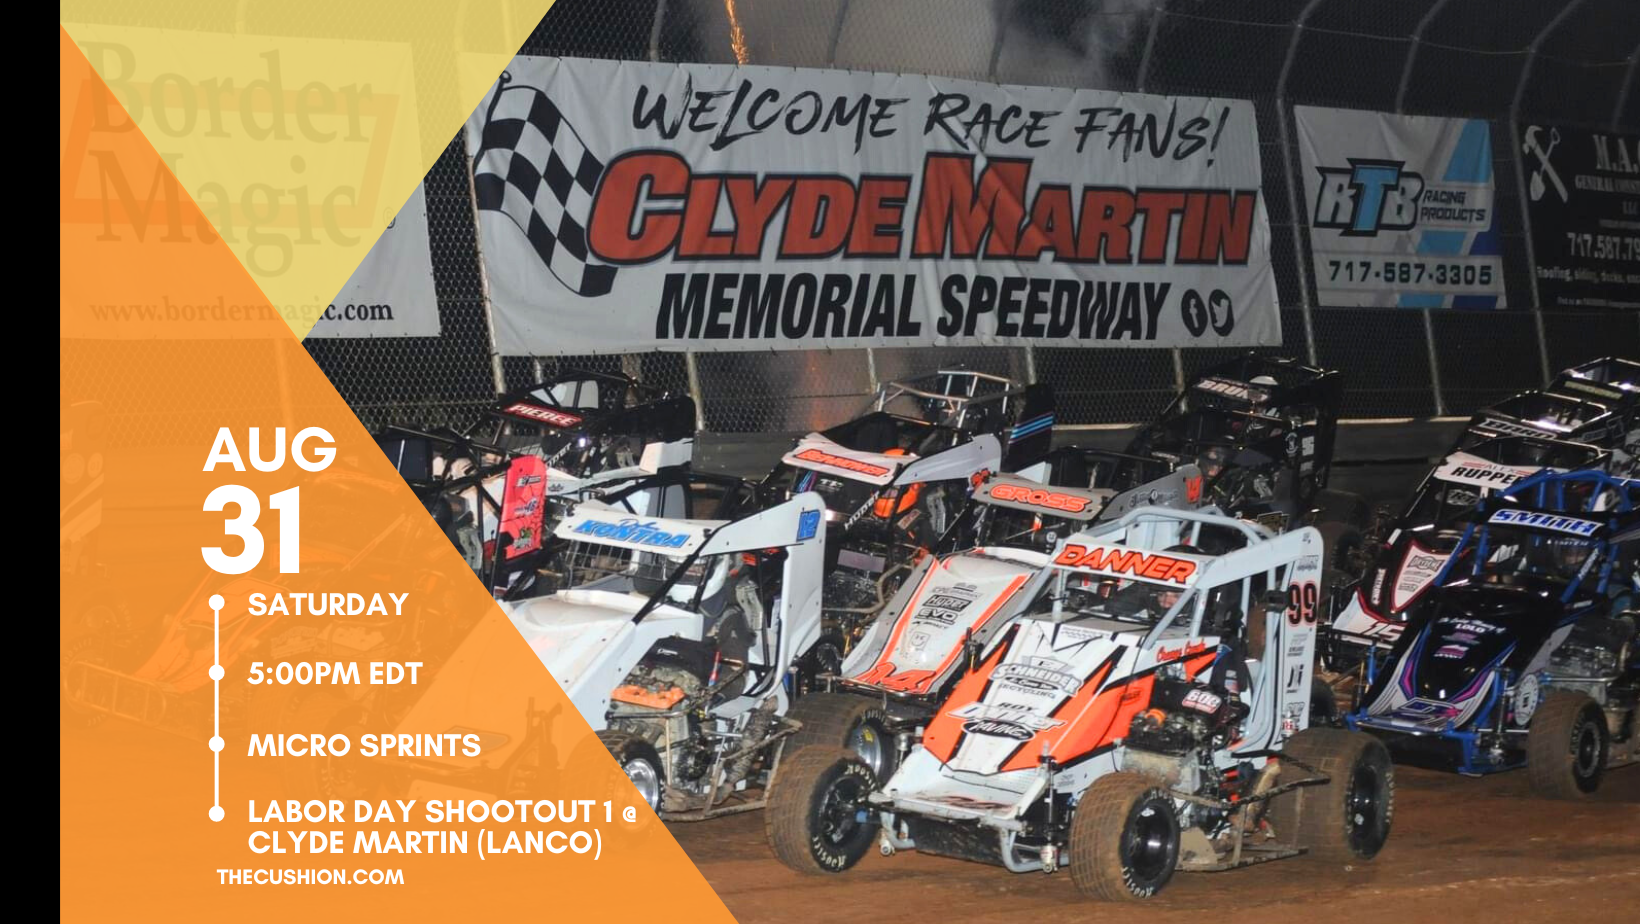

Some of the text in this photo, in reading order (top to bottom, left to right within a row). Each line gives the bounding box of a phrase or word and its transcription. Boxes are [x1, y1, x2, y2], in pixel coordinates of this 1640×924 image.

[77, 39, 374, 143] Border
[632, 73, 1230, 168] WELCOME RACE FANS!
[88, 149, 364, 279] Magic
[585, 148, 1257, 266] CLYDE MARTIN
[1313, 157, 1425, 237] RTB
[1420, 206, 1488, 222] PRODUCTS
[1422, 189, 1467, 204] RACING
[89, 296, 394, 329] www.bordermagic.com
[655, 272, 1172, 341] MEMORIAL SPEEDWAY
[507, 403, 578, 427] PIERCE
[990, 483, 1093, 514] GROSS
[574, 519, 692, 549] KONTRA
[1495, 508, 1599, 536] SMITH
[1054, 543, 1201, 584] DANNER
[1288, 581, 1318, 626] 99
